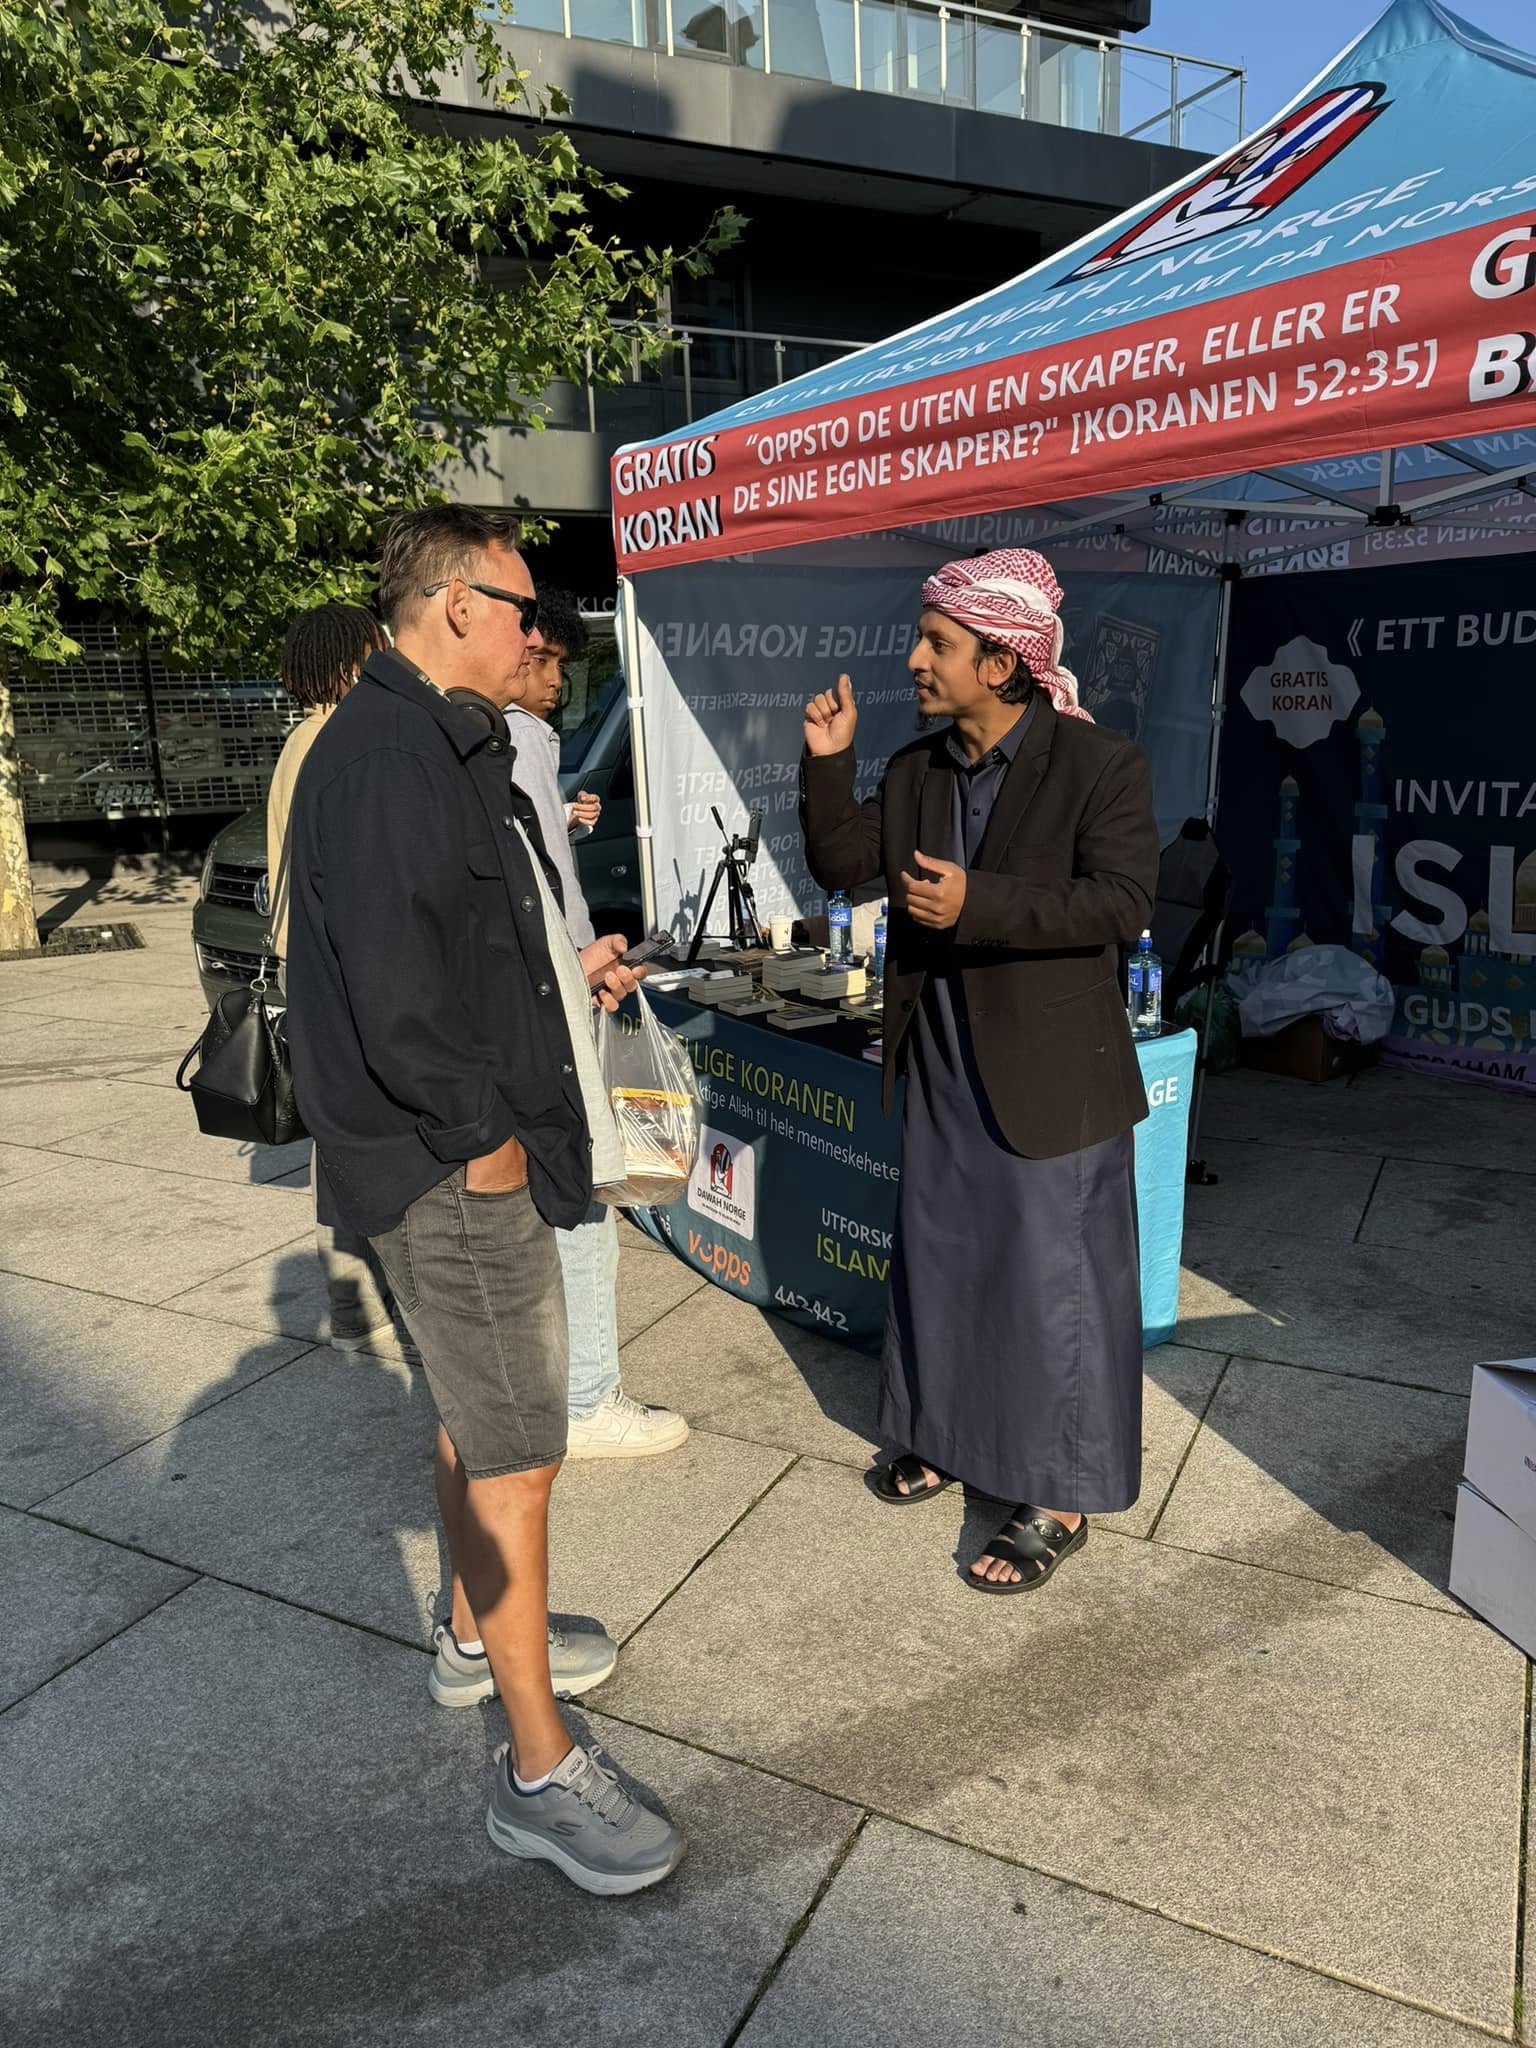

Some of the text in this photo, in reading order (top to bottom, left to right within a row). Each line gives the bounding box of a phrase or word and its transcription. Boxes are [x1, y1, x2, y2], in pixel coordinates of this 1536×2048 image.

[1129, 168, 1446, 287] NORGE
[1008, 318, 1067, 345] TIL
[1075, 265, 1245, 326] ISLAM
[859, 410, 892, 442] DE
[900, 385, 976, 432] UTEN
[987, 371, 1030, 413] EN
[1039, 336, 1186, 401] SKAPER,
[1202, 300, 1326, 366] ELLER
[1341, 283, 1402, 335] ER
[733, 484, 760, 515] DE
[766, 472, 819, 507] SINE
[826, 452, 892, 495] EGNE
[1070, 371, 1278, 455] [KORANEN
[1293, 338, 1438, 407] 52:35]
[615, 436, 718, 497] GRATIS
[620, 495, 722, 555] KORAN
[1376, 615, 1445, 651] ETT
[1270, 671, 1329, 688] GRATIS
[1272, 694, 1333, 711] KORAN
[1403, 994, 1513, 1036] GUDS
[741, 1061, 856, 1132] KORANEN
[728, 1094, 754, 1121] Allah
[756, 1107, 768, 1126] til
[770, 1113, 795, 1141] hele
[797, 1128, 900, 1182] menneskehete
[696, 1187, 722, 1208] DAWAH
[722, 1200, 747, 1221] NORGE
